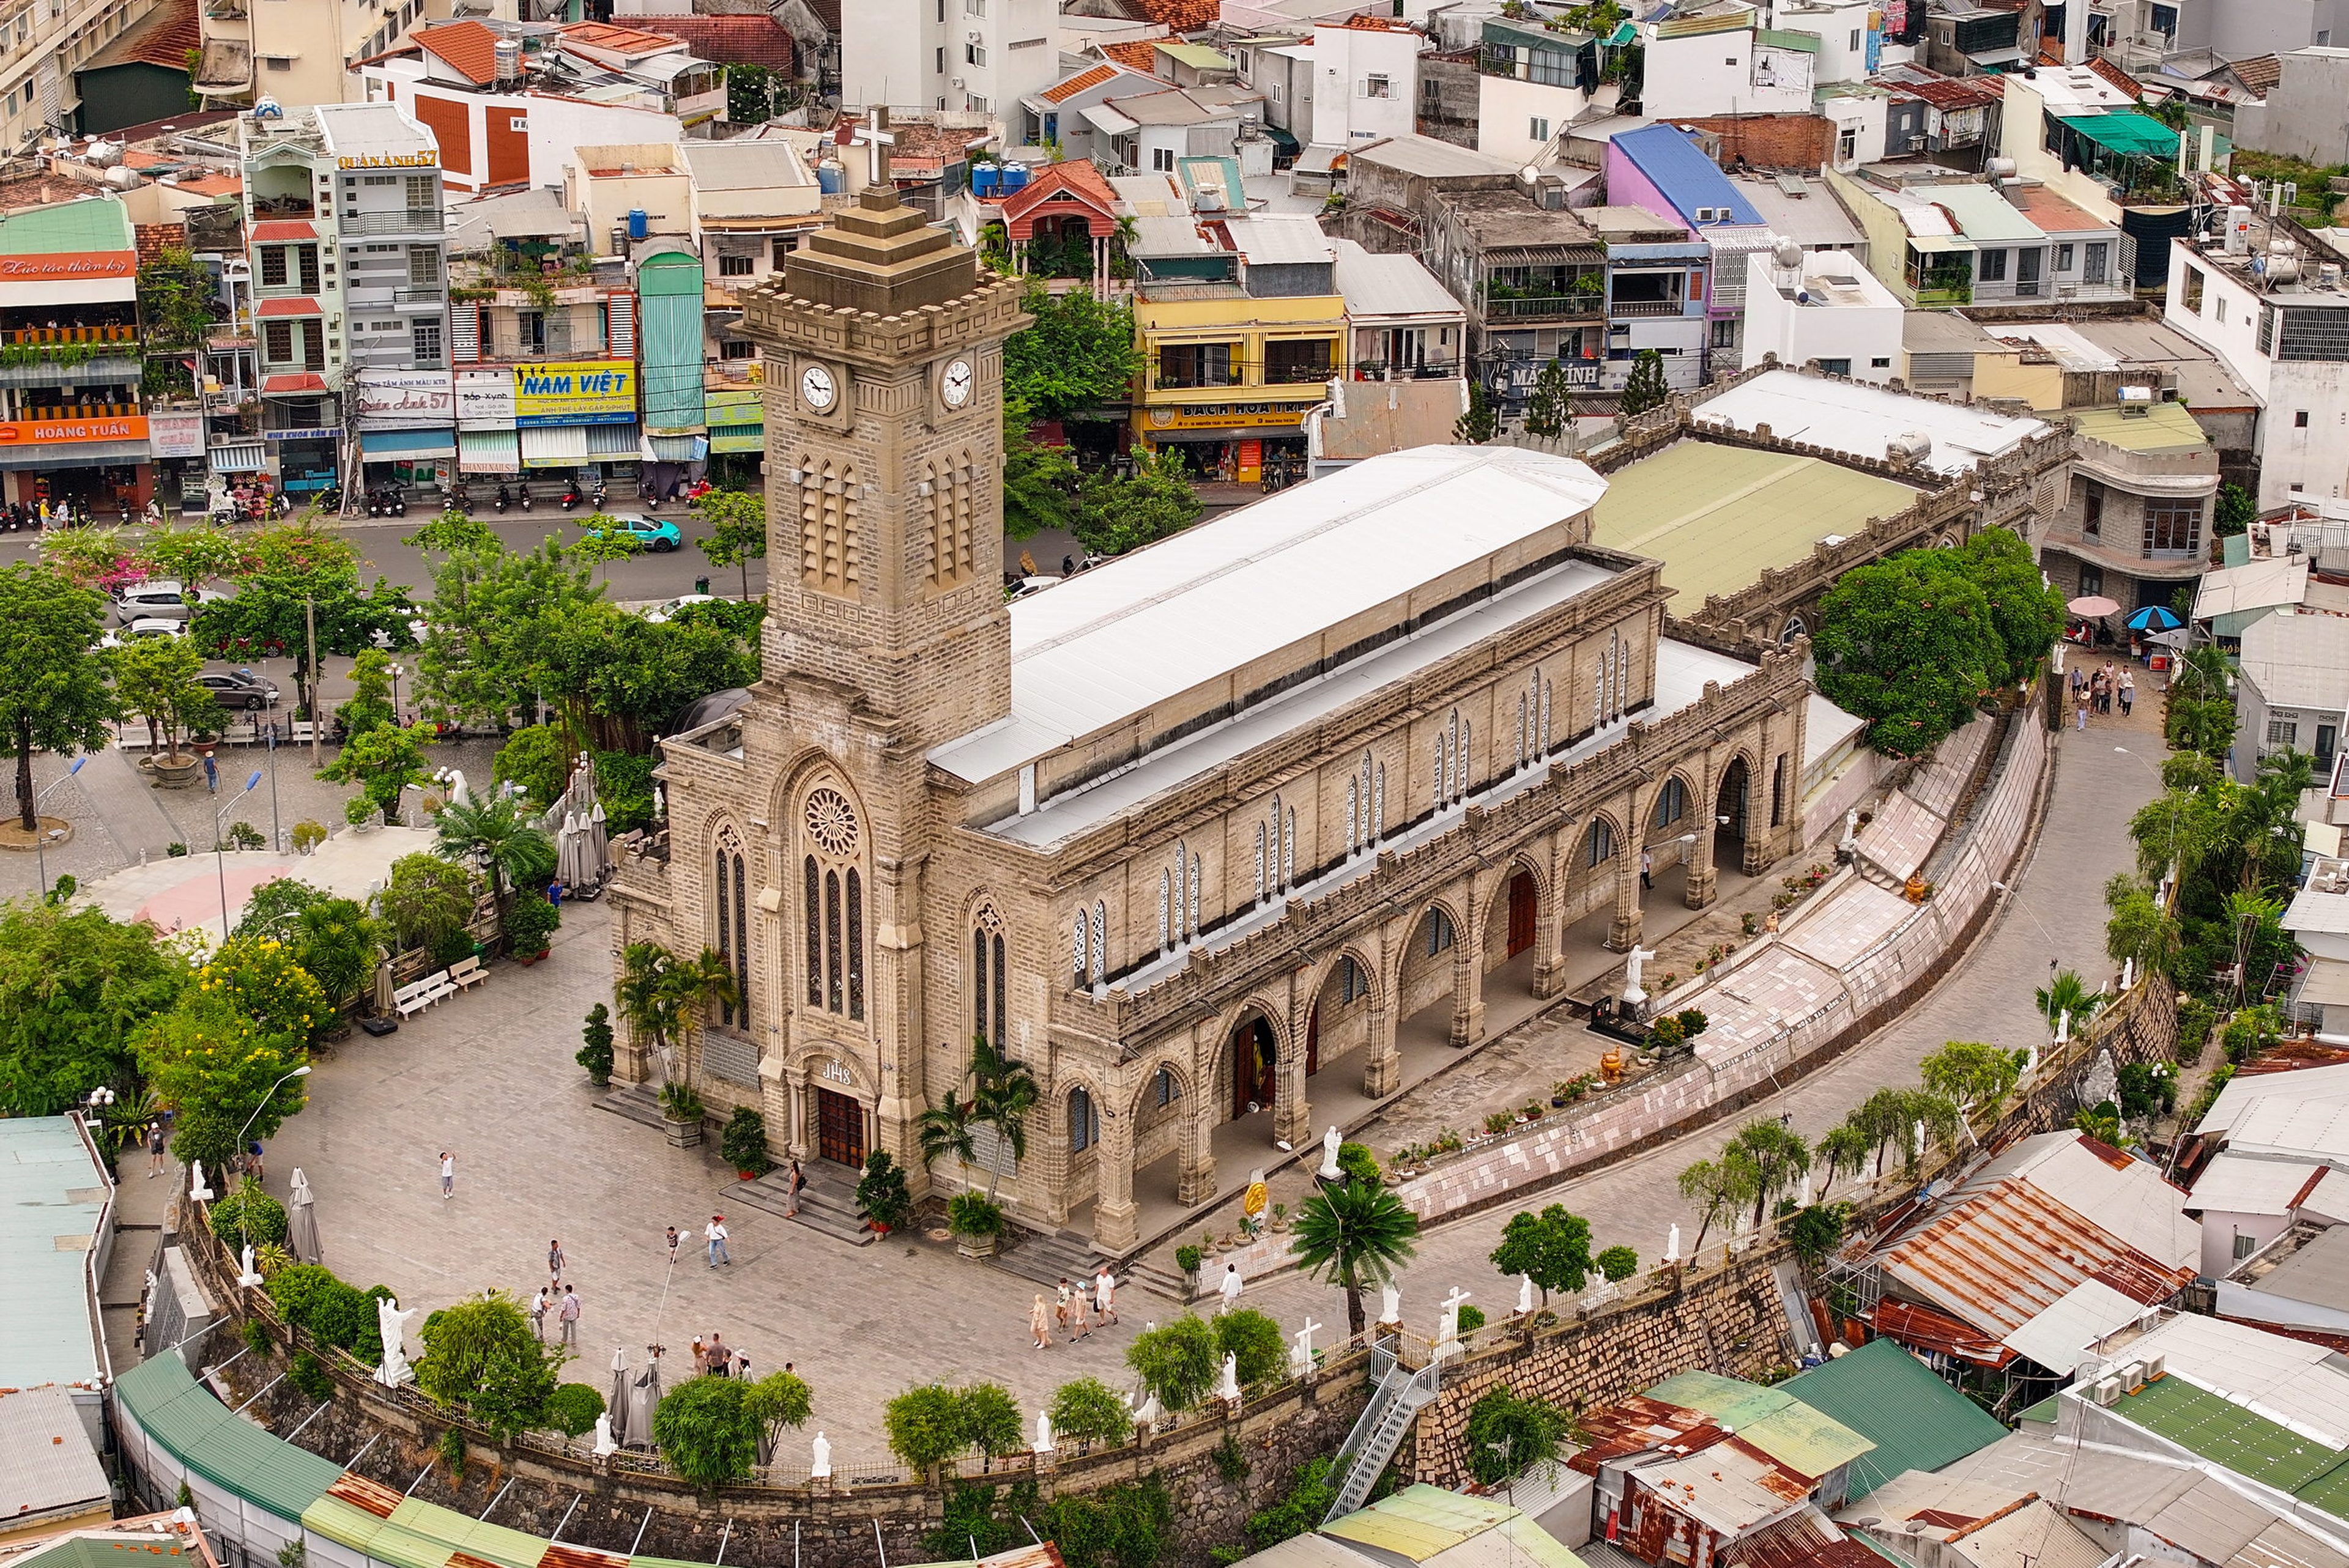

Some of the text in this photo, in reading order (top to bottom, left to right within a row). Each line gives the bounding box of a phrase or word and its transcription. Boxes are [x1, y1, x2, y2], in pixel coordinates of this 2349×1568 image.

[338, 150, 437, 170] QUÁN ẢNH 57
[523, 370, 628, 396] NAM VIỆT
[429, 393, 450, 409] 57
[35, 421, 130, 439] HOÀNG TUẤN
